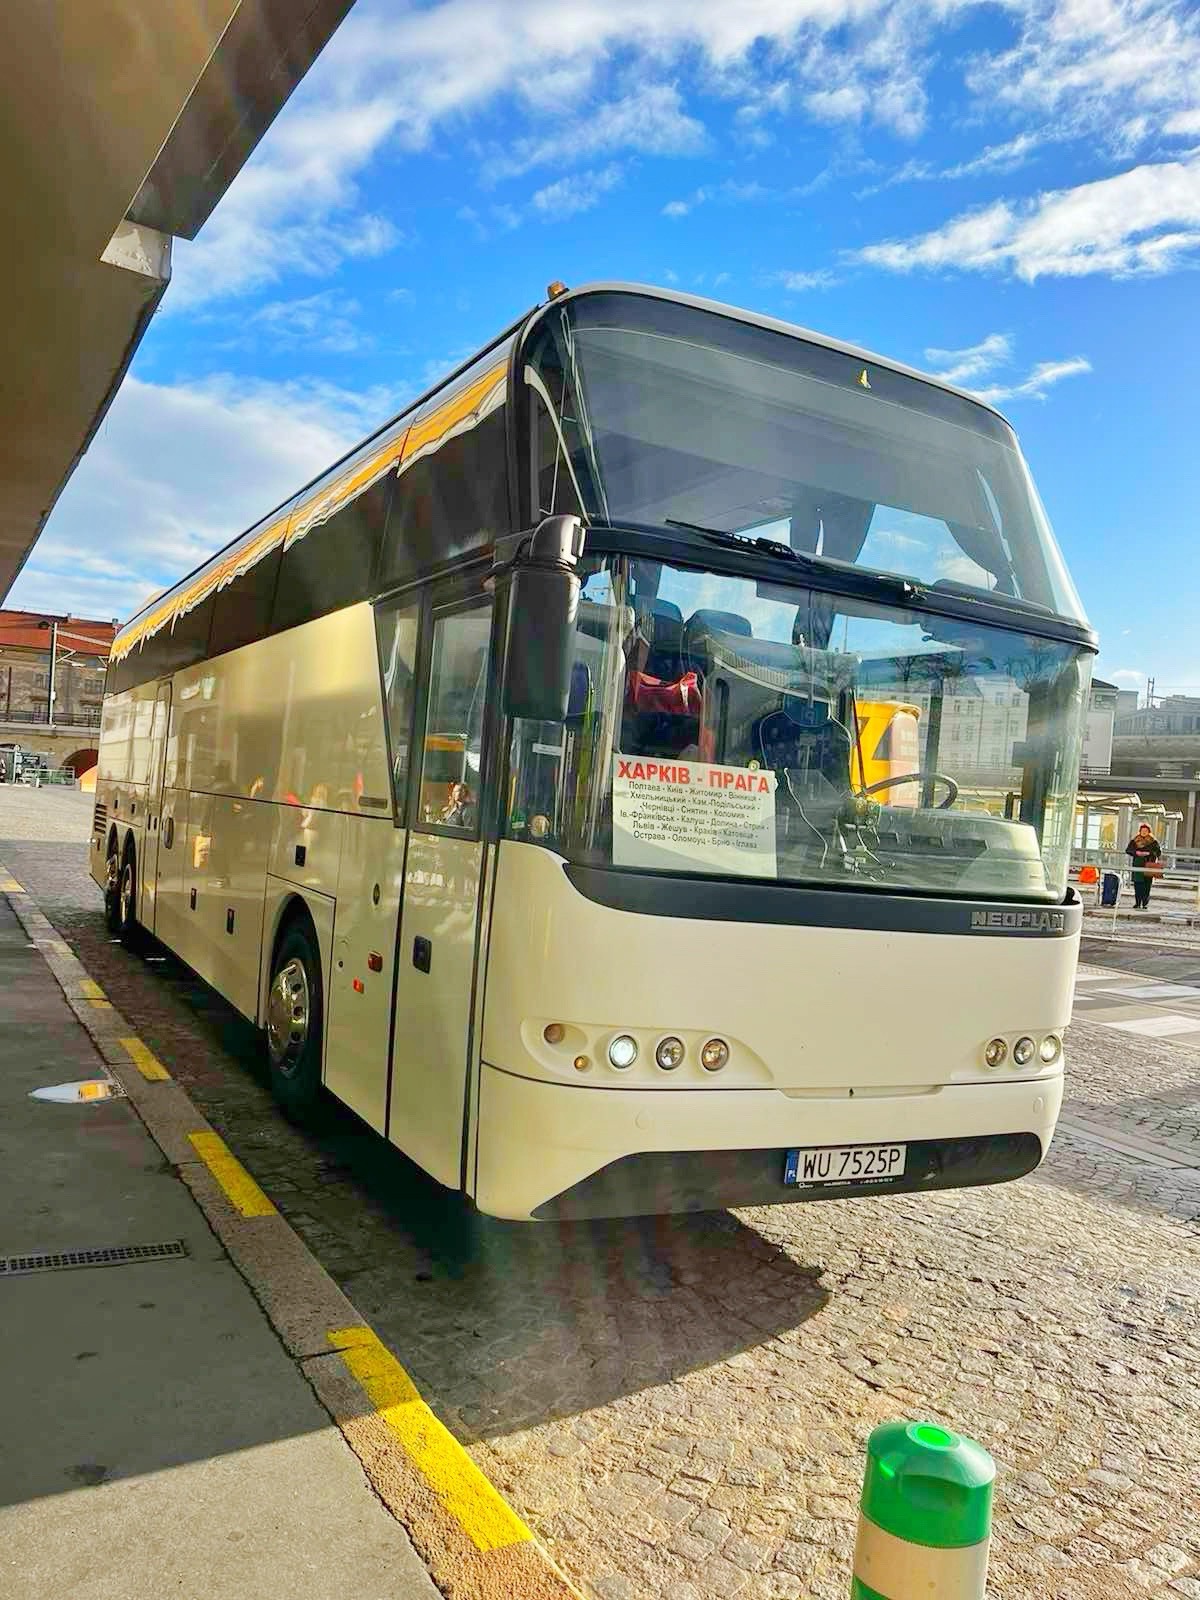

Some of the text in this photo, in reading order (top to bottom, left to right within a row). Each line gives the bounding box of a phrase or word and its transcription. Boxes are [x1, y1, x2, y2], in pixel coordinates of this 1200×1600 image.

[618, 761, 691, 784] ХАРКІВ
[709, 771, 769, 793] ПРАГА
[629, 781, 661, 792] Полтава
[667, 785, 683, 794] Київ
[690, 788, 722, 798] Житомир
[630, 791, 686, 802] Хмельницький
[681, 806, 708, 815] Снятин
[633, 820, 654, 830] Львів
[661, 823, 688, 833] Жешув
[681, 815, 704, 826] Калуш
[634, 830, 666, 840] Острава
[672, 834, 706, 845] Оломоуц
[971, 912, 1064, 930] NEOPLAN
[804, 1152, 832, 1178] WU
[838, 1148, 900, 1176] 7525P
